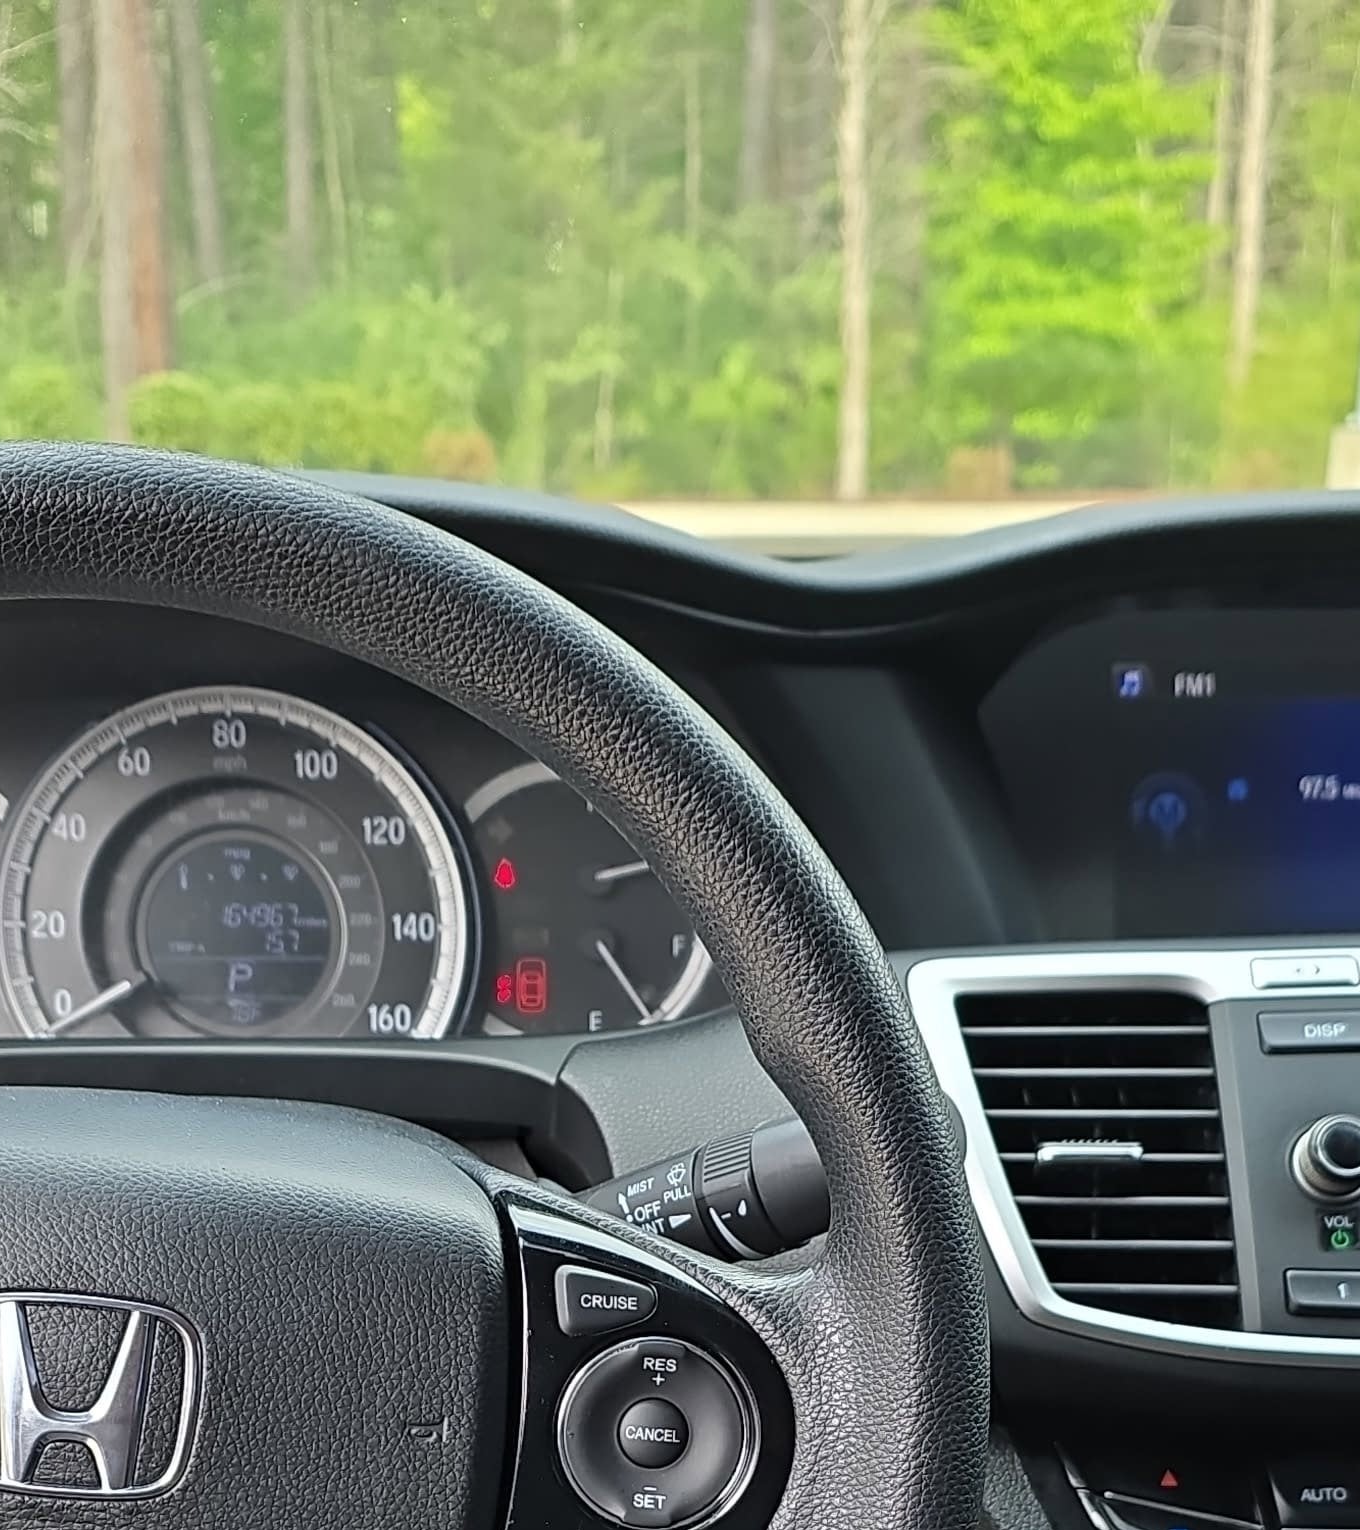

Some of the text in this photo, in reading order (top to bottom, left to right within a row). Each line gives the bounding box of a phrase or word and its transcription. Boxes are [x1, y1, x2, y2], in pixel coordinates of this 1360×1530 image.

[1174, 672, 1215, 697] FM1
[212, 719, 246, 748] 80
[118, 747, 150, 777] 60
[213, 756, 248, 773] mph
[295, 749, 337, 780] 100
[52, 814, 86, 842] 40
[363, 816, 406, 846] 120
[33, 911, 64, 938] 20
[392, 912, 435, 942] 140
[672, 935, 686, 957] F
[229, 963, 252, 990] P
[55, 988, 72, 1015] 0
[369, 1003, 412, 1033] 160
[589, 1009, 603, 1032] E
[1304, 1022, 1346, 1039] DISP
[626, 1176, 655, 1197] MIST
[663, 1184, 692, 1204] PULL
[634, 1200, 662, 1222] OFF
[1324, 1215, 1354, 1229] VOL
[580, 1294, 638, 1311] CRUISE
[1338, 1284, 1349, 1300] 1
[643, 1357, 677, 1373] RES
[625, 1425, 681, 1443] CANCEL
[633, 1493, 666, 1510] SET
[1300, 1487, 1348, 1503] AUTO
